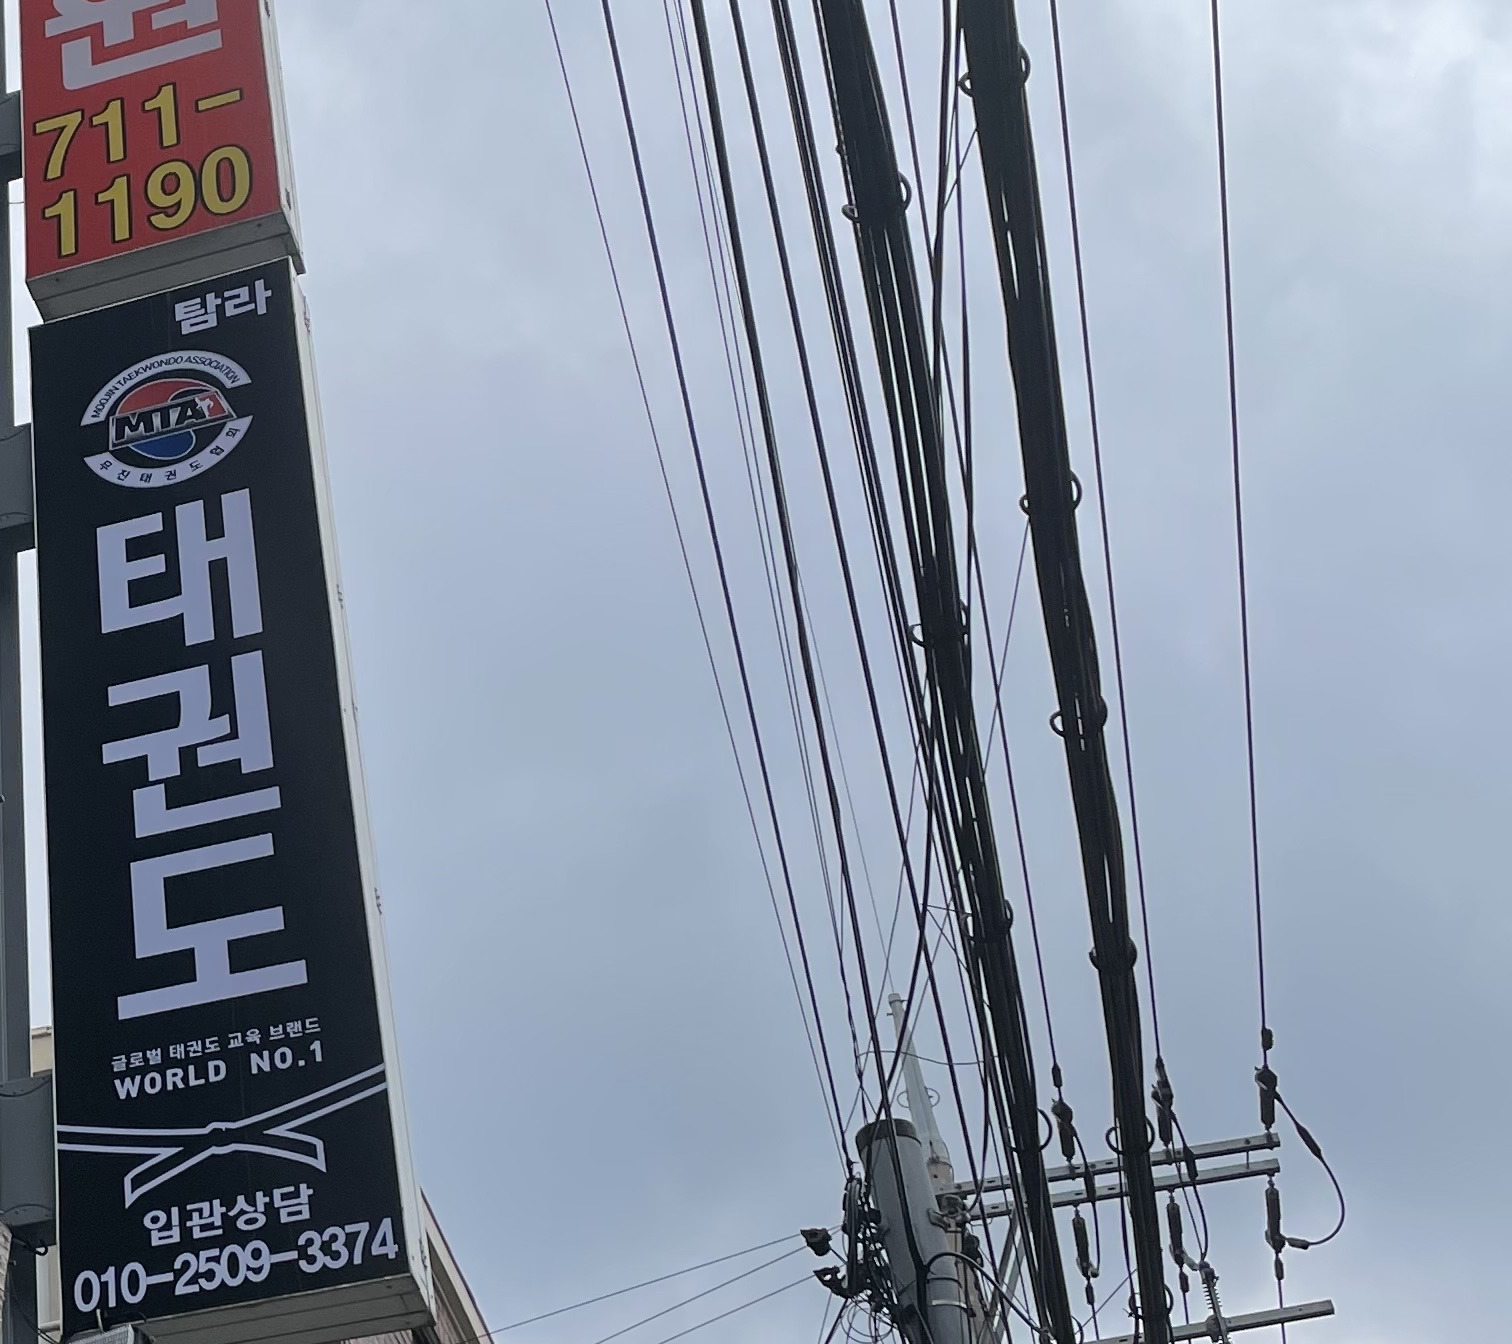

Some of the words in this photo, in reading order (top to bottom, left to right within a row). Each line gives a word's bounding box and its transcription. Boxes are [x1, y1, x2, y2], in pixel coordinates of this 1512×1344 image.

[34, 84, 243, 182] 711-
[41, 144, 252, 258] 1190
[174, 278, 273, 336] 탐라
[90, 384, 122, 419] MOOJIN
[116, 355, 184, 392] TAEKWONDO
[183, 355, 241, 385] ASSOCIATION
[114, 396, 211, 443] MTA
[95, 487, 308, 1021] 태권도
[110, 1047, 163, 1072] 글로벌
[168, 1036, 221, 1060] 태권도
[227, 1027, 262, 1049] 교육
[268, 1016, 322, 1041] 브랜드
[113, 1059, 228, 1101] WORLD
[249, 1039, 324, 1075] NO.1
[142, 1182, 314, 1247] 입관상담
[73, 1216, 399, 1314] 010-2509-3374
